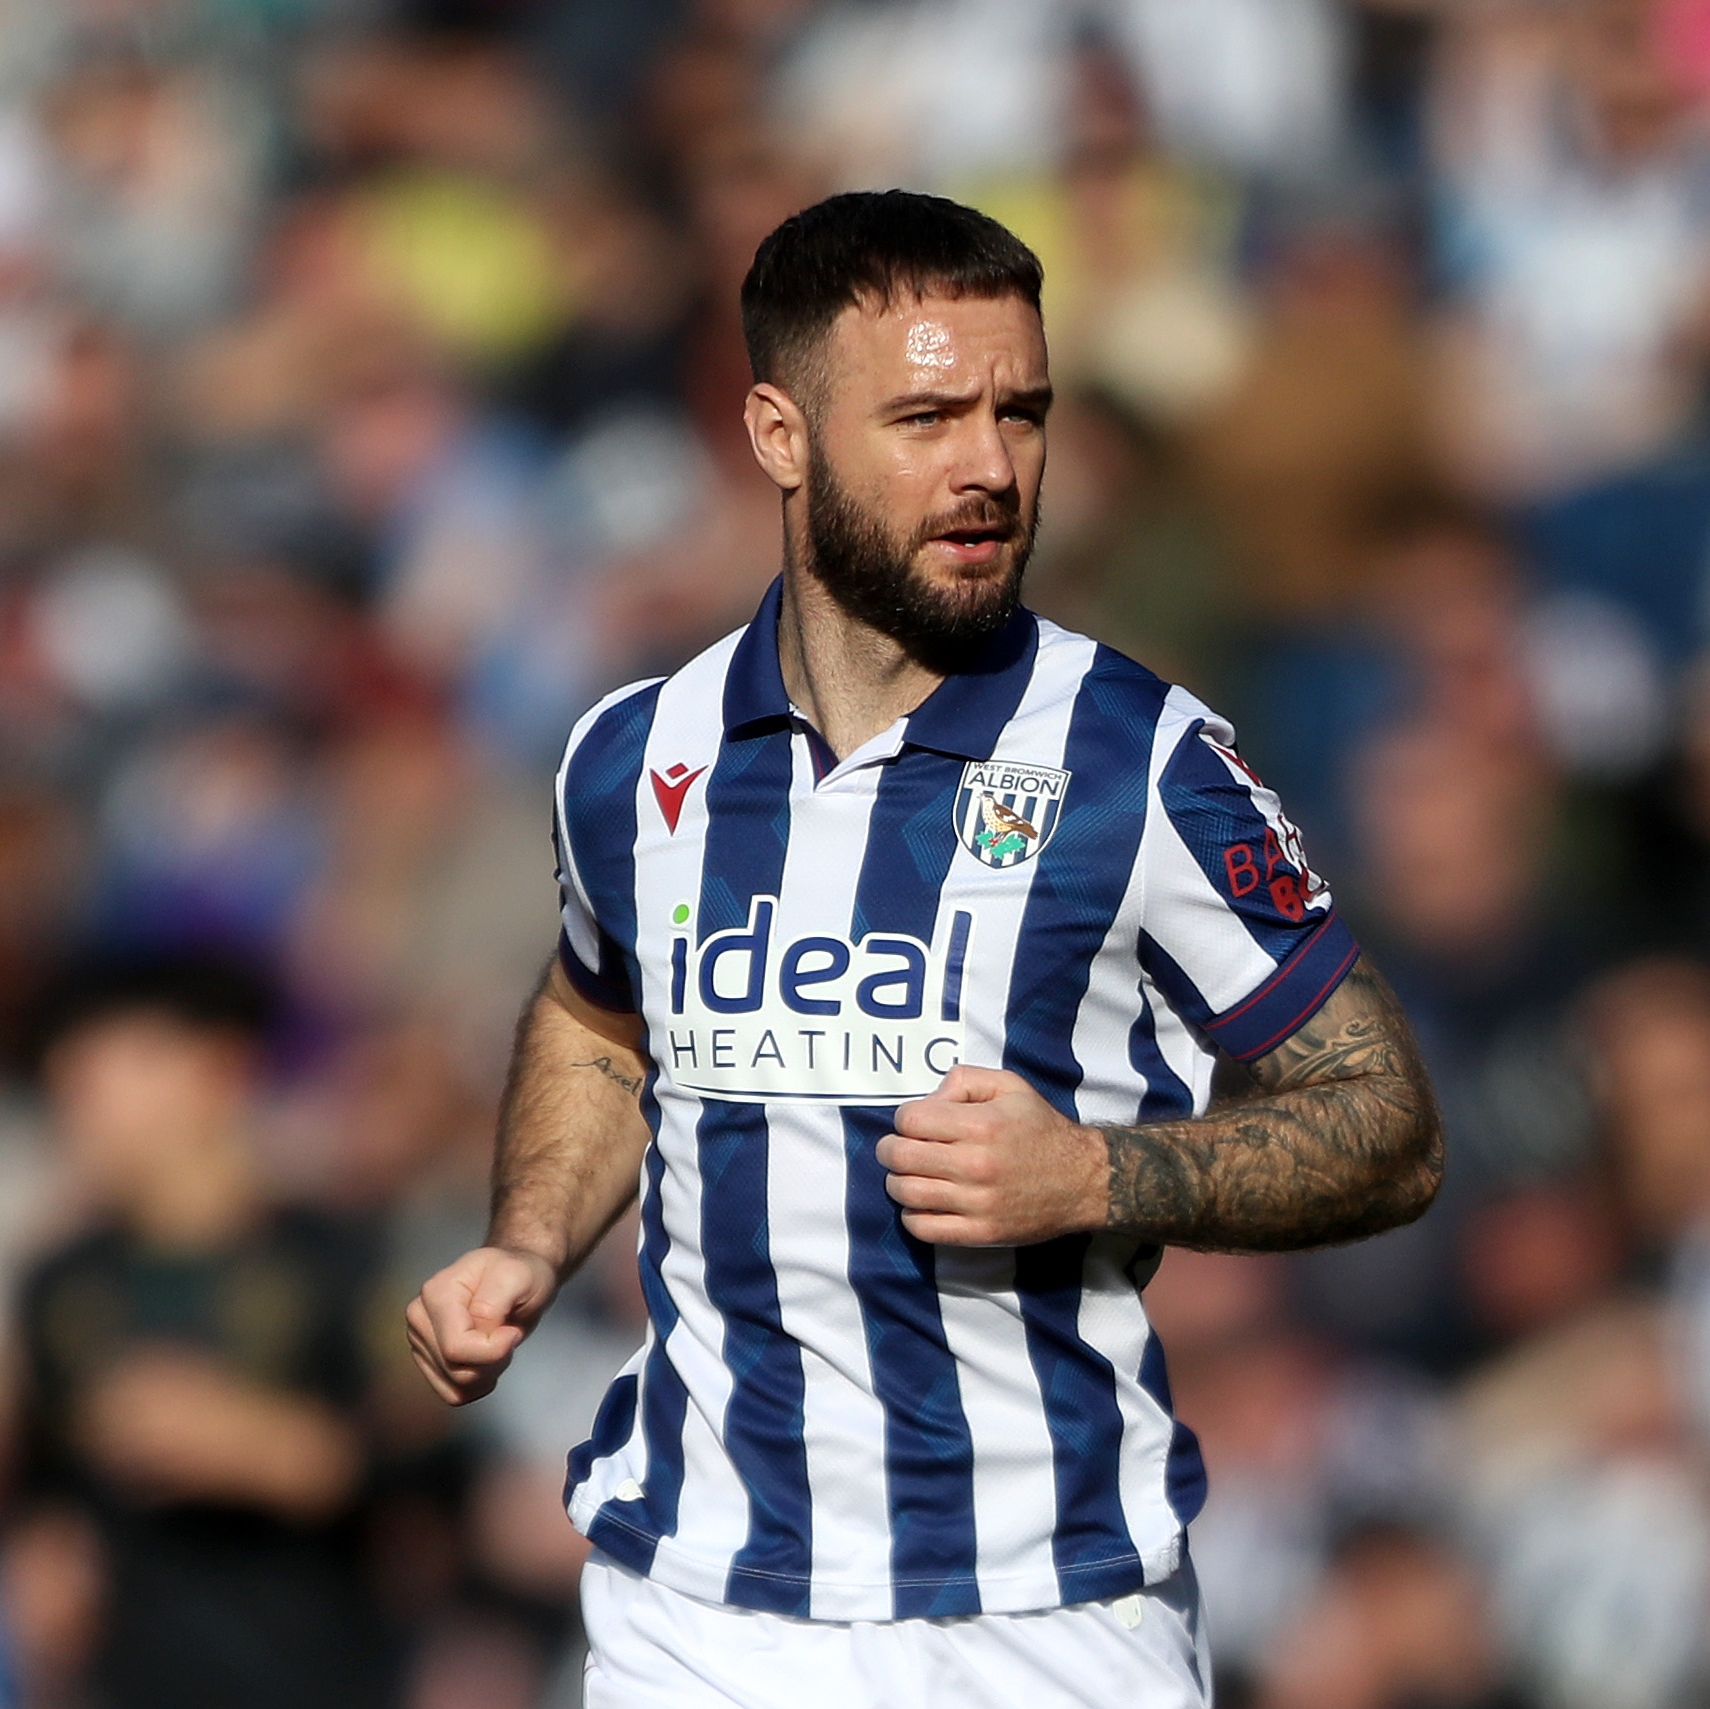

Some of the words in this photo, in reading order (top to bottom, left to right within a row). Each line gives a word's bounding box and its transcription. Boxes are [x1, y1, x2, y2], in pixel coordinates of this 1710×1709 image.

[968, 770, 1059, 796] ALBION
[973, 761, 1003, 772] WEST
[1004, 766, 1063, 781] BROMWICH
[671, 900, 972, 1022] ideal
[669, 1029, 960, 1076] HEATING
